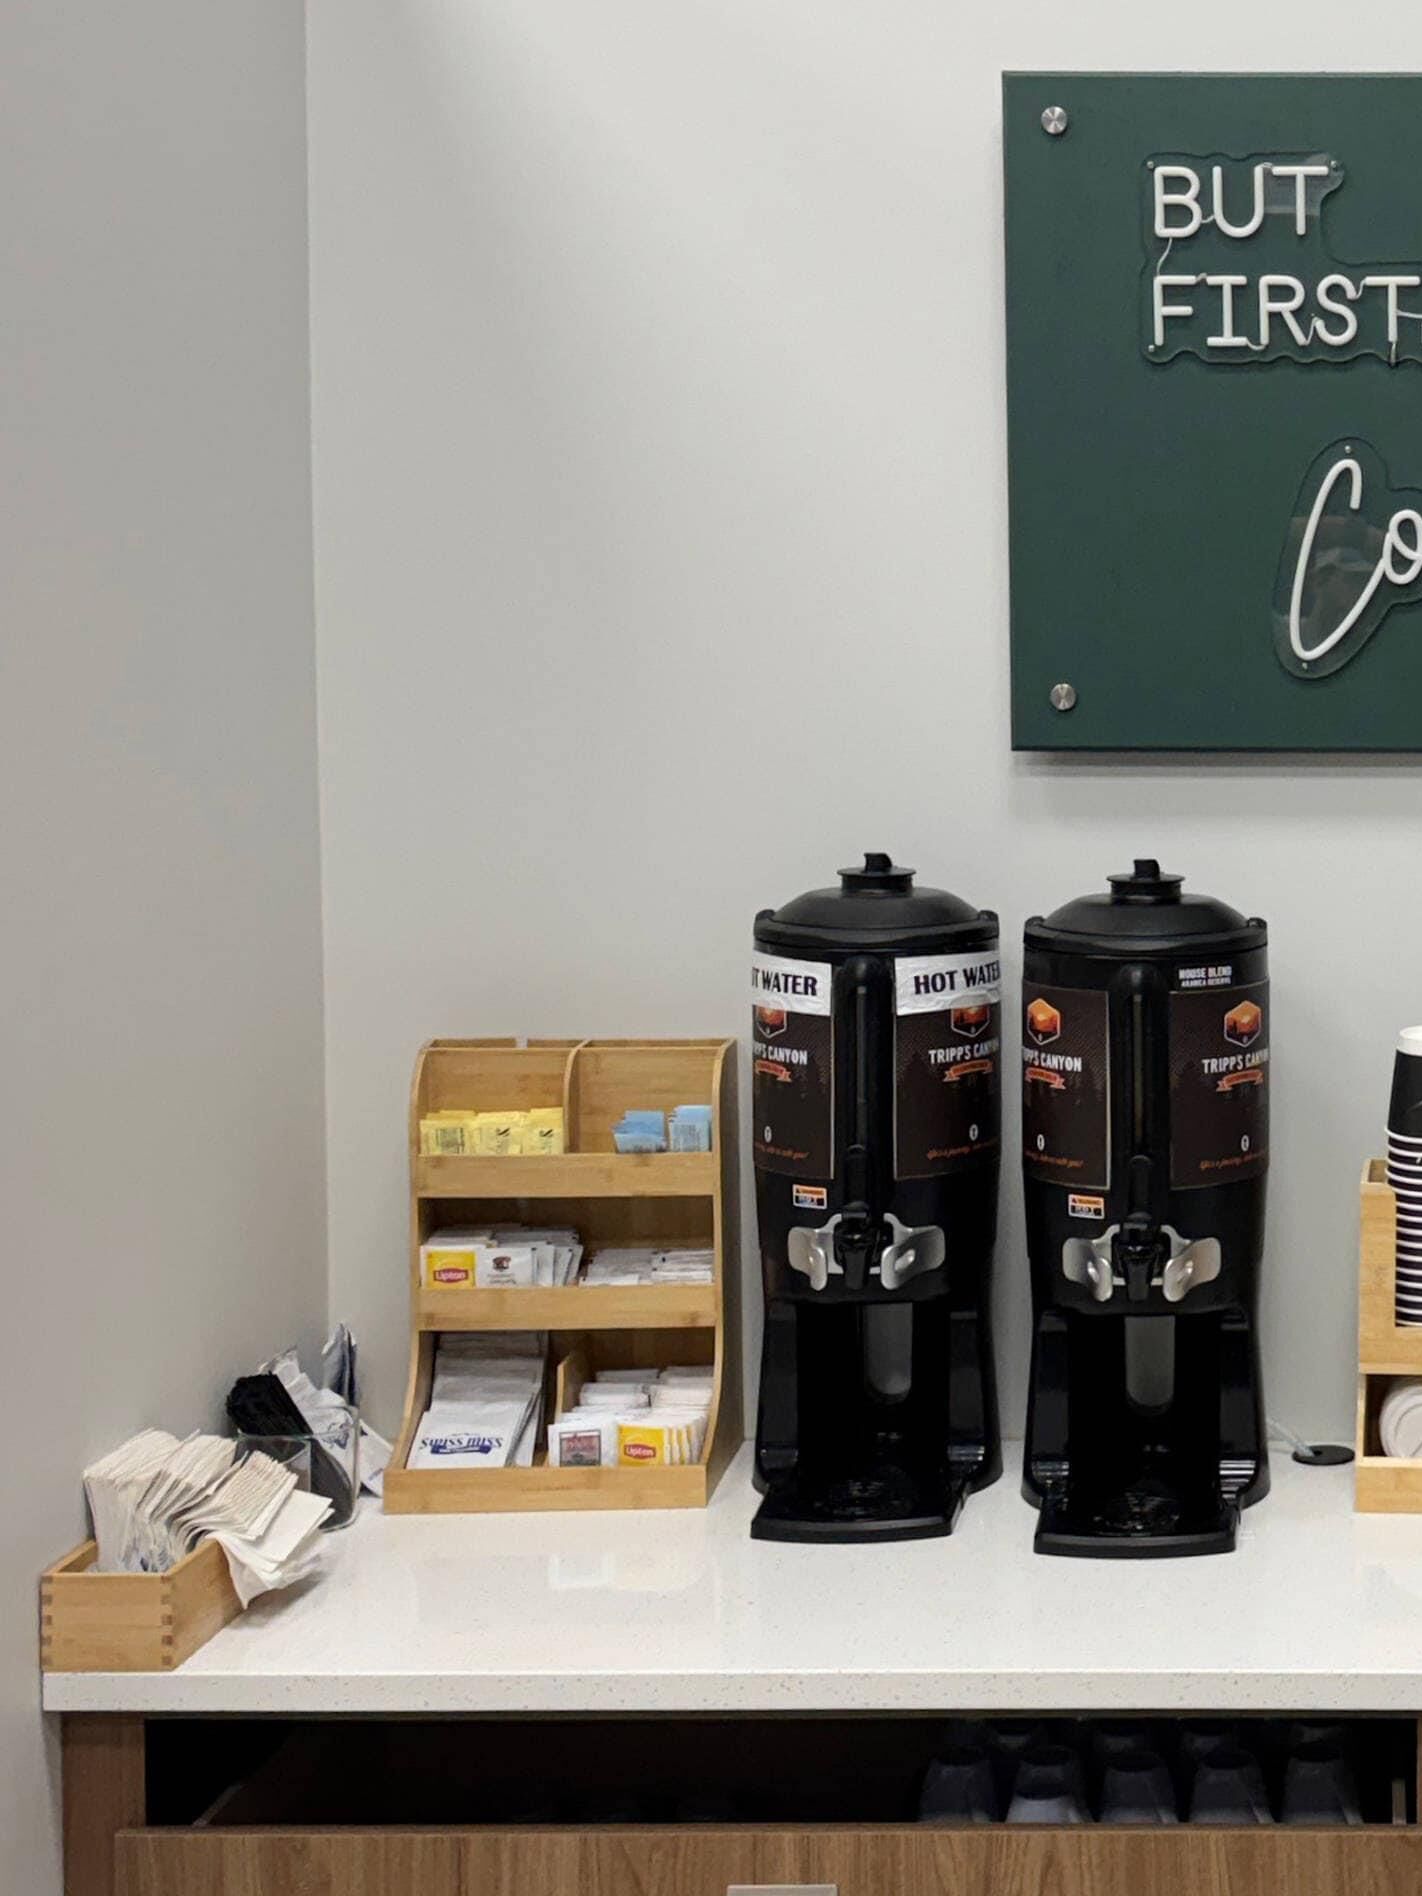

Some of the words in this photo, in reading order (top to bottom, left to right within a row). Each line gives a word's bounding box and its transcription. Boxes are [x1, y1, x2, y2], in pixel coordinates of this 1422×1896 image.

[1154, 165, 1329, 239] BUT
[761, 968, 818, 996] WATER
[914, 970, 958, 995] HOT
[767, 1045, 808, 1065] CANYON
[1040, 1051, 1082, 1072] CANYON
[436, 1270, 467, 1282] Lipton
[625, 1445, 656, 1458] Lipton
